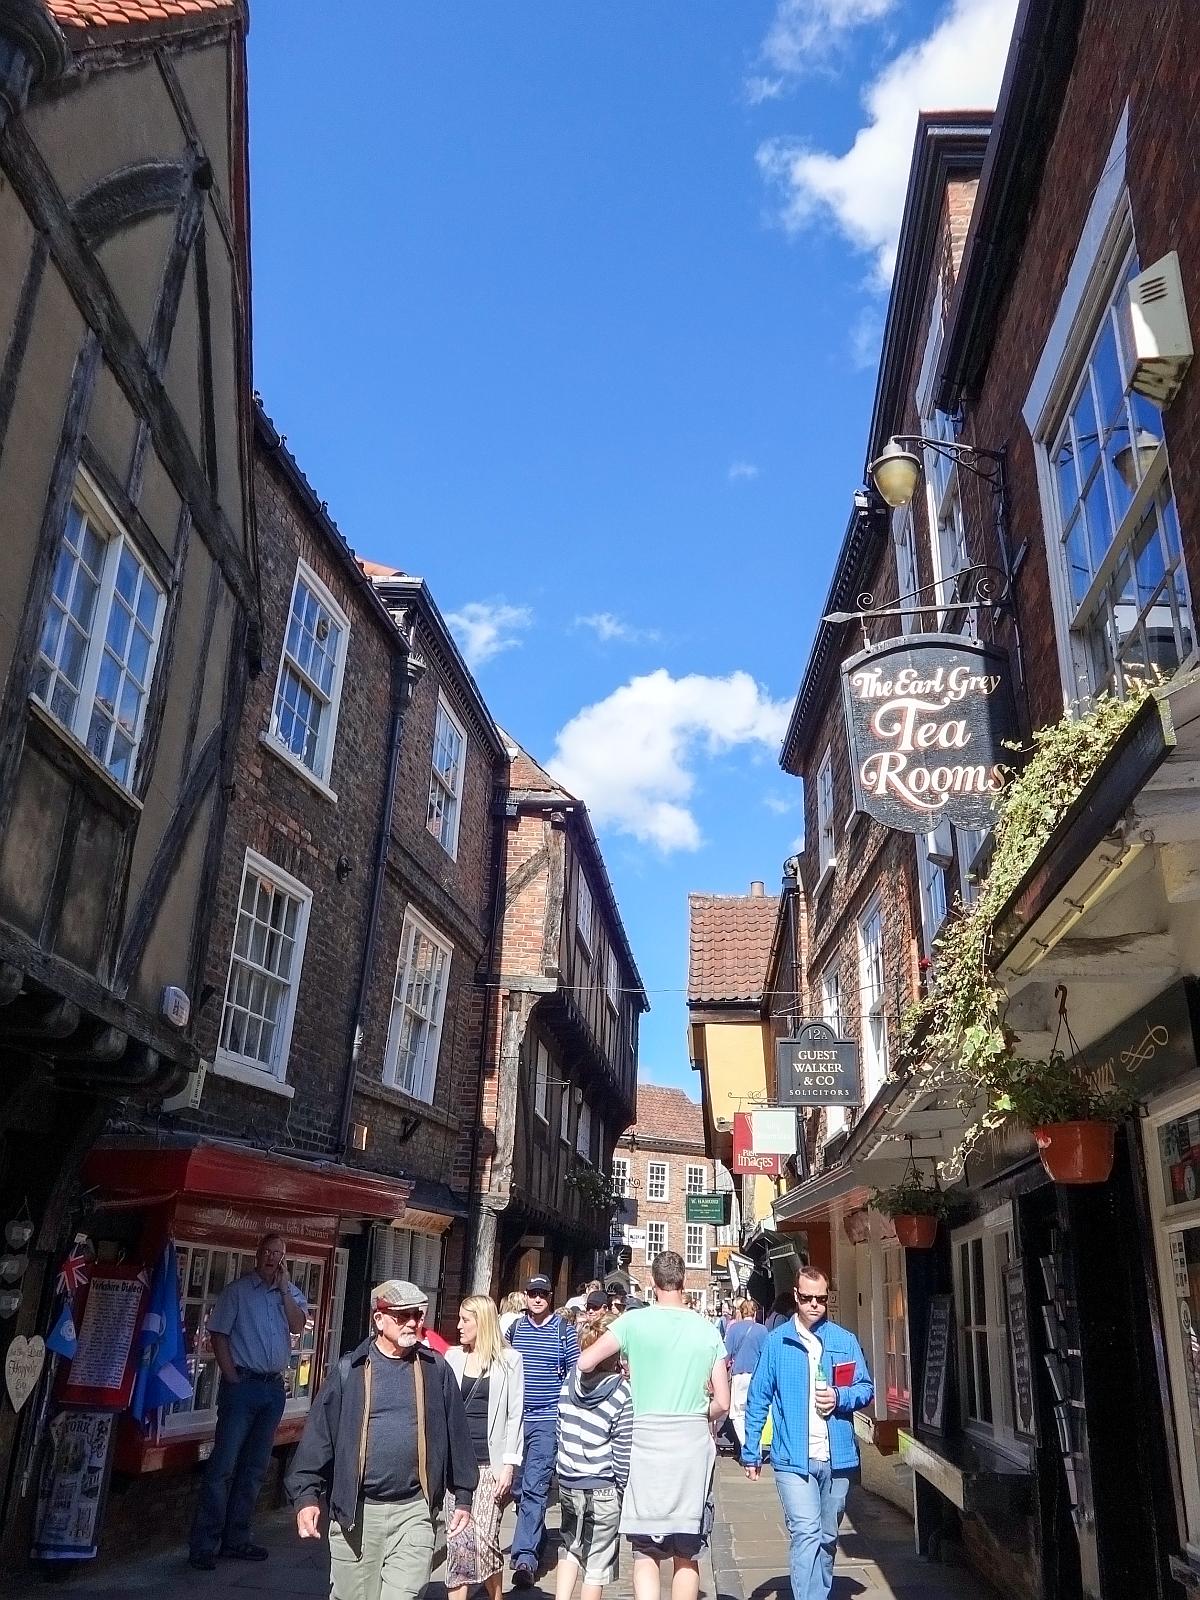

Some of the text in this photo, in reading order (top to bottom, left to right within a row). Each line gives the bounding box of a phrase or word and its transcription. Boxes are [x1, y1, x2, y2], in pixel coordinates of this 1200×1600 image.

[852, 666, 1001, 701] The Earl Grey
[874, 697, 972, 751] Tea
[860, 752, 1007, 808] Rooms
[807, 1028, 828, 1040] 12A
[798, 1050, 838, 1060] GUEST
[792, 1063, 844, 1073] WALKER
[803, 1075, 835, 1086] & CO
[92, 1279, 120, 1292] Yorkshire
